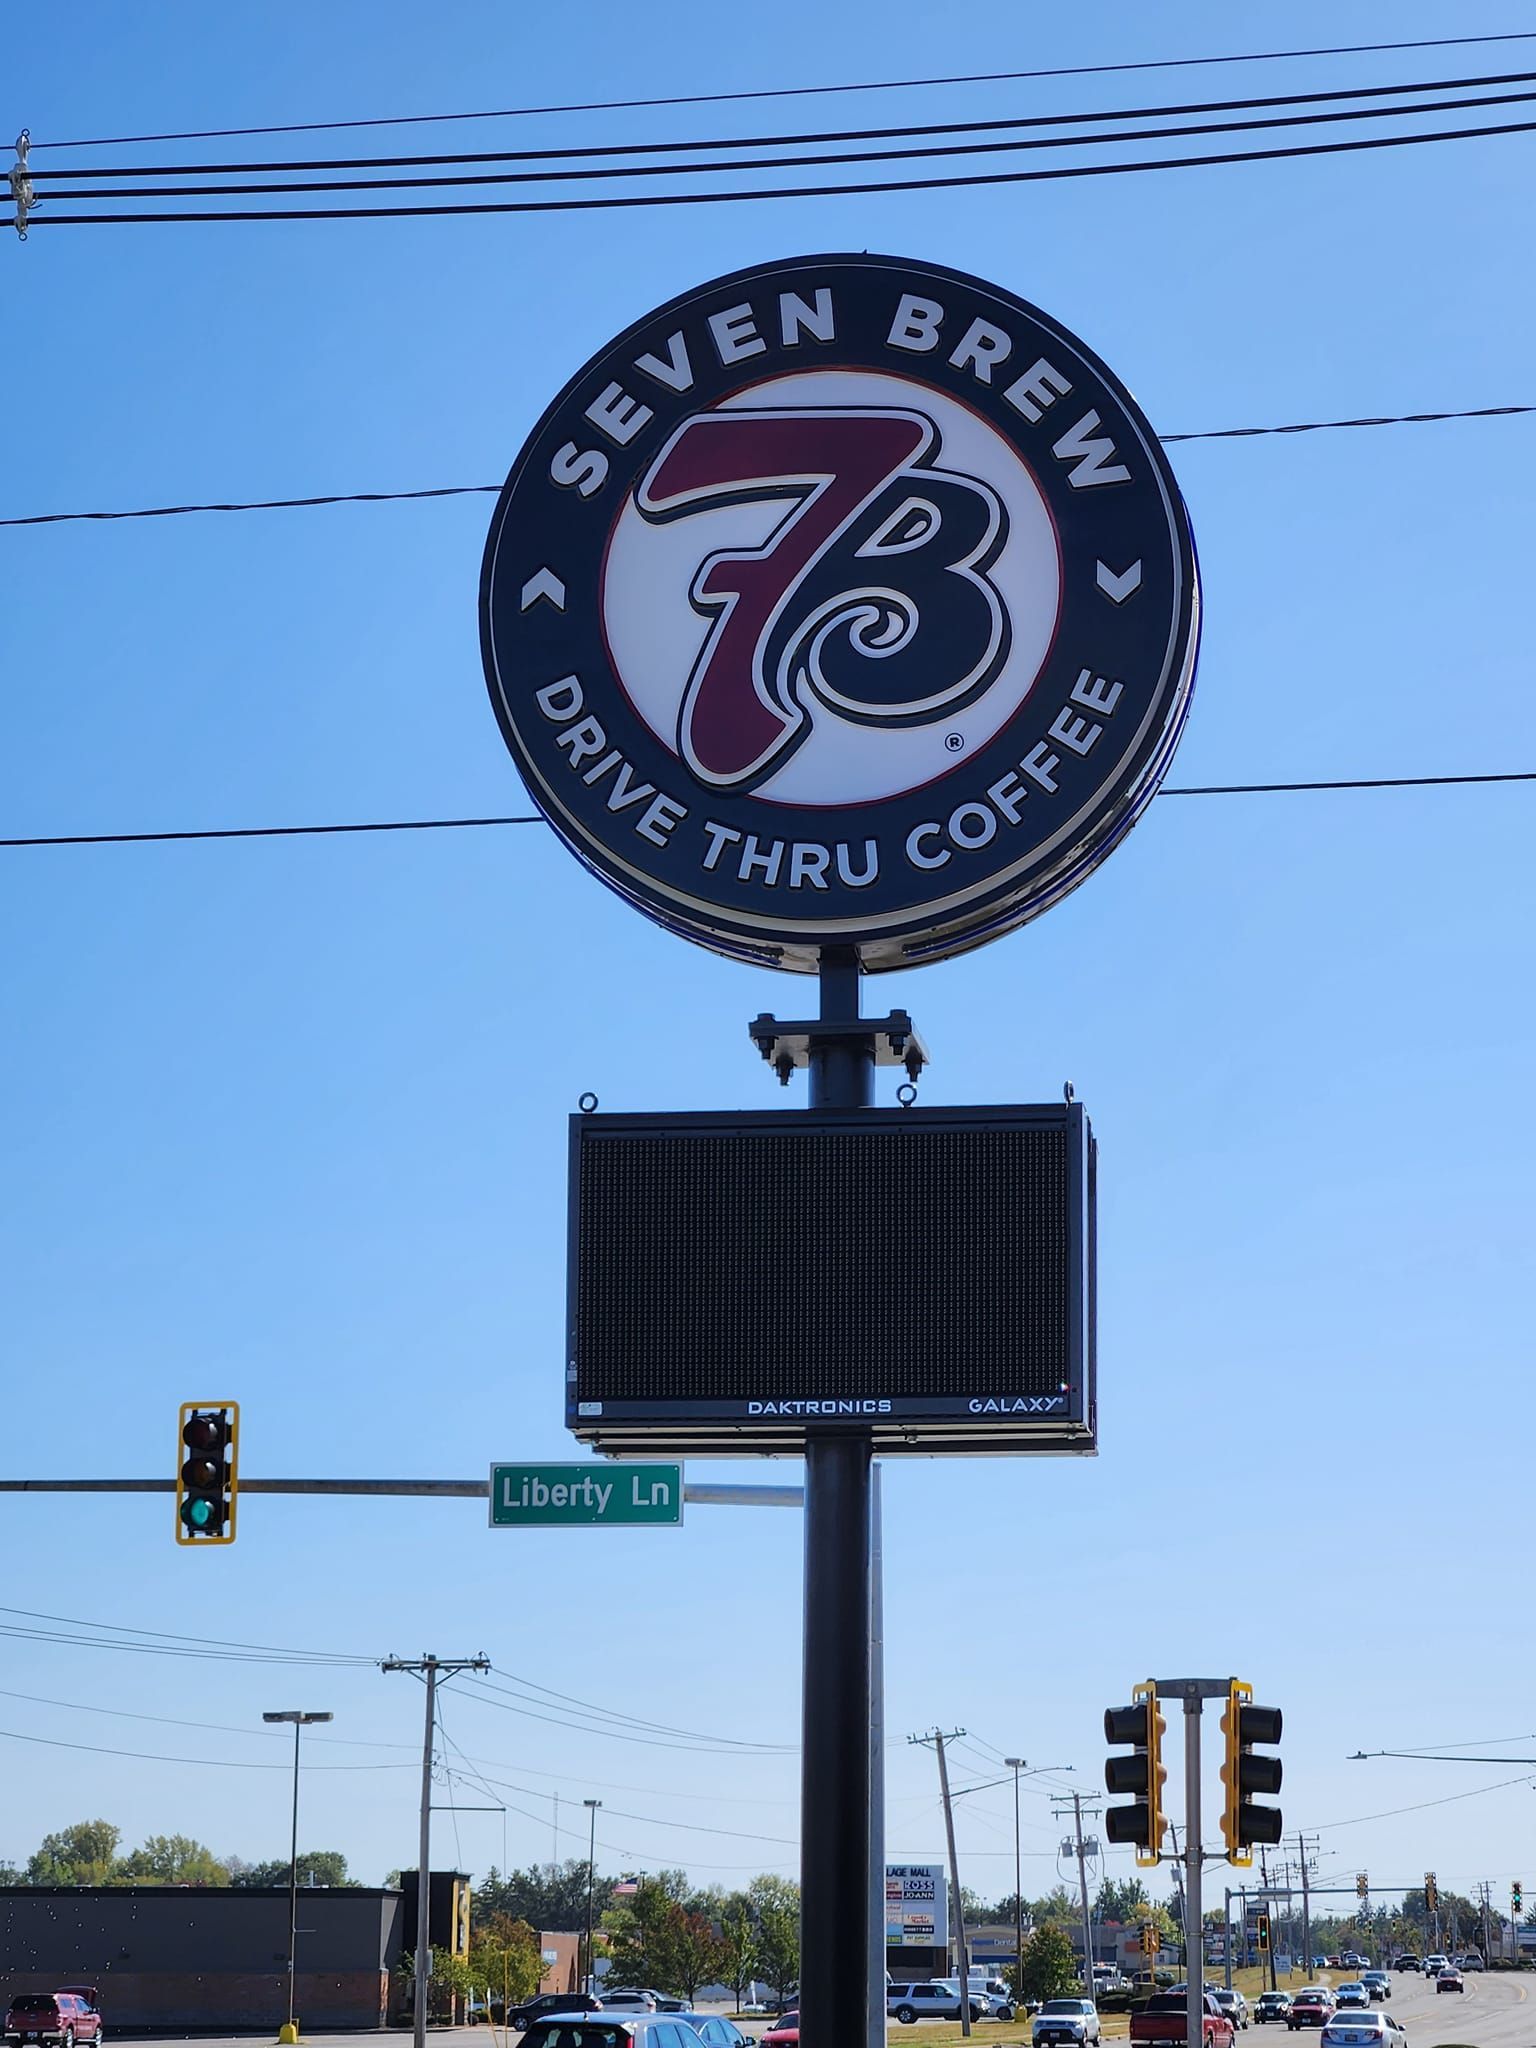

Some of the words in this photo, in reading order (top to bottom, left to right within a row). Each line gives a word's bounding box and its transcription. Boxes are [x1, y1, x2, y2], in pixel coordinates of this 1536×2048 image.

[550, 287, 837, 498] SEVEN
[887, 293, 1132, 490] BREW
[535, 673, 689, 848] DRIVE
[701, 821, 880, 889] THRU
[904, 668, 1125, 870] COFFEE
[748, 1399, 892, 1415] DAKTRONICS
[503, 1476, 613, 1514] Liberty
[632, 1475, 669, 1506] Ln
[886, 1867, 907, 1877] LAGE
[910, 1867, 931, 1877] MALL
[904, 1881, 934, 1890] ROSS
